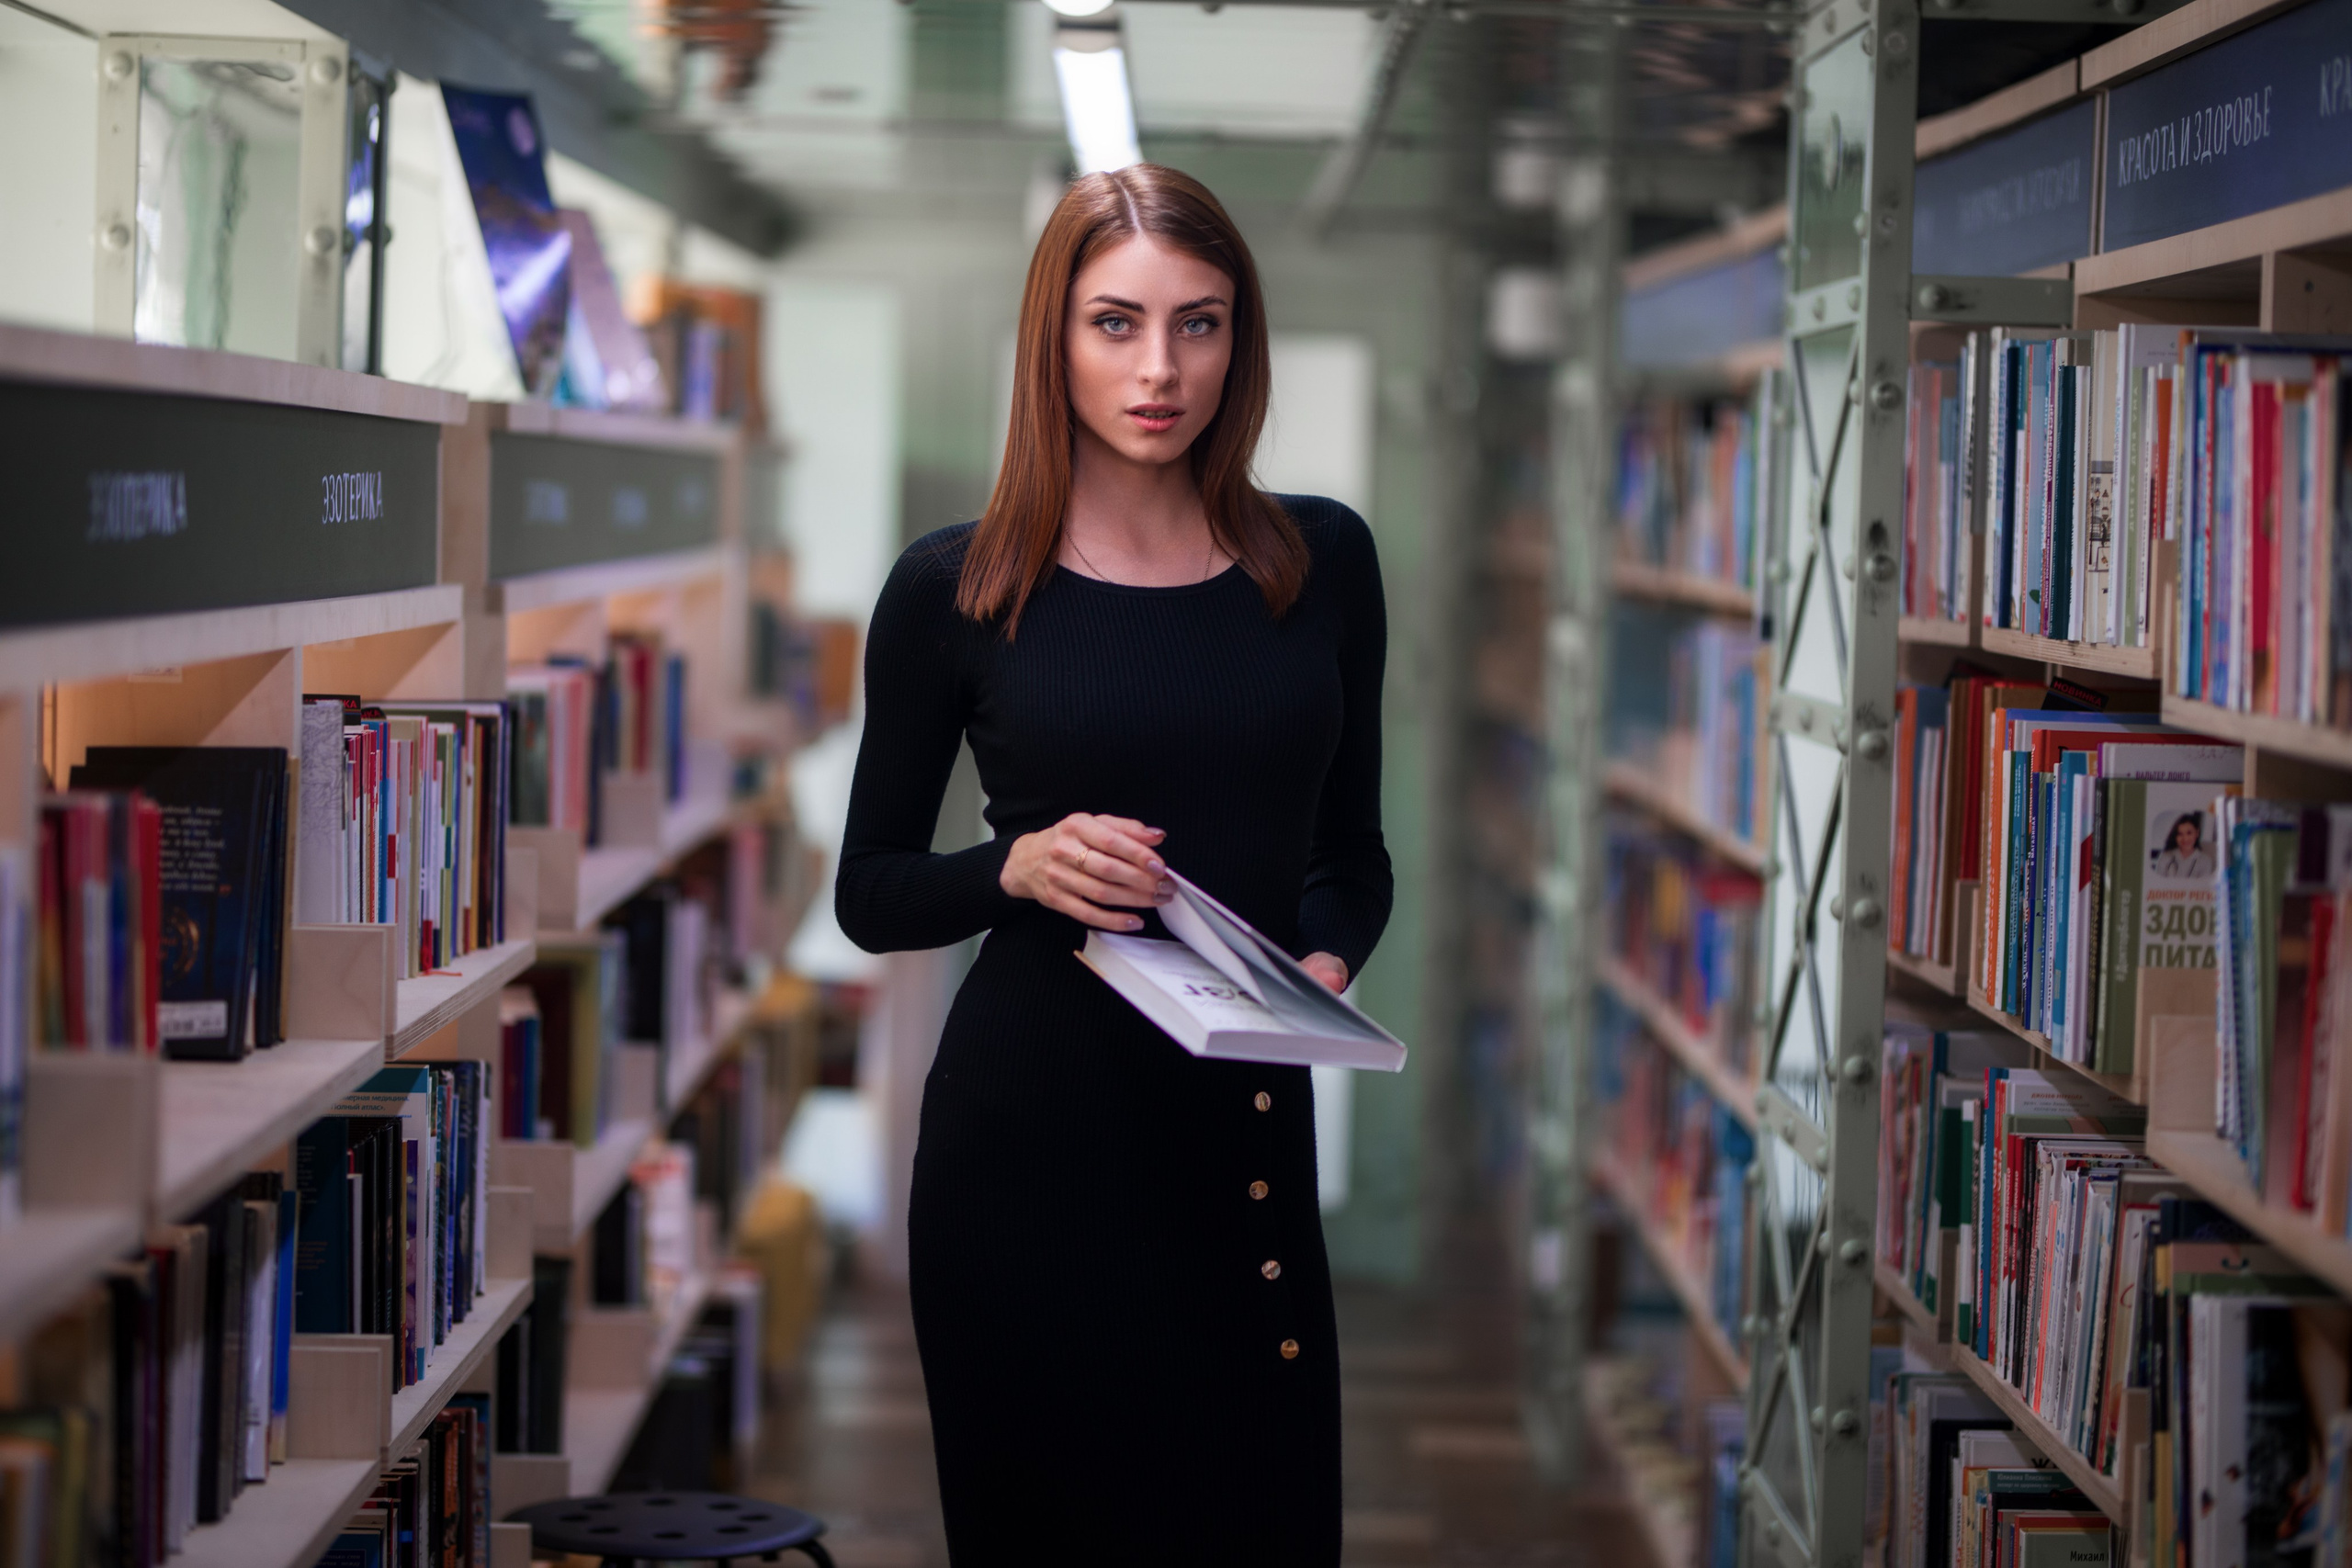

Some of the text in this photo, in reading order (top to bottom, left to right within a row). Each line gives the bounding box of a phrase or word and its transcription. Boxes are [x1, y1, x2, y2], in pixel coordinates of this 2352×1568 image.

[2117, 85, 2272, 187] КРАСОТА И ЗДОРОВЬЕ
[2127, 385, 2139, 532] ДИЕТА ДЛЯ УМА
[322, 470, 384, 525] ЭЗОТЕРИКА
[2053, 681, 2102, 706] НОВИНКА
[2135, 771, 2190, 781] ВАЛЬТЕР ЛОНГО
[2146, 890, 2187, 901] ДОКТОР
[2069, 1550, 2105, 1562] Михаил
